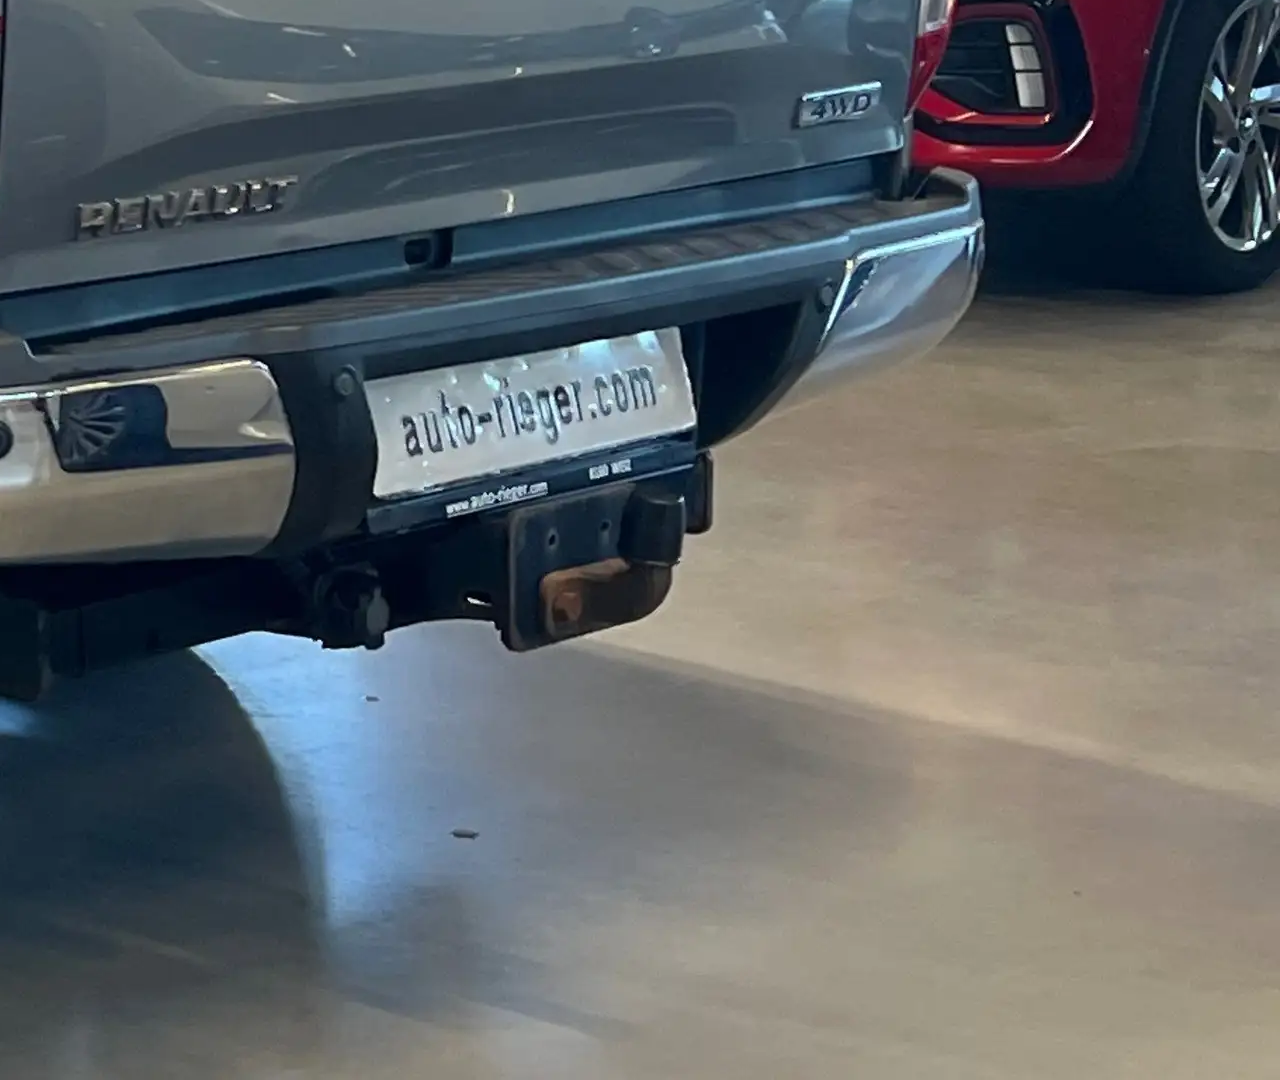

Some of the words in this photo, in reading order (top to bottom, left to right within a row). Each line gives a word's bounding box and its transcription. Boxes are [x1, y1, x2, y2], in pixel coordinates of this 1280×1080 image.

[810, 92, 872, 119] 4WD
[75, 175, 298, 240] RENAULT
[401, 365, 656, 457] auto-rieger.com
